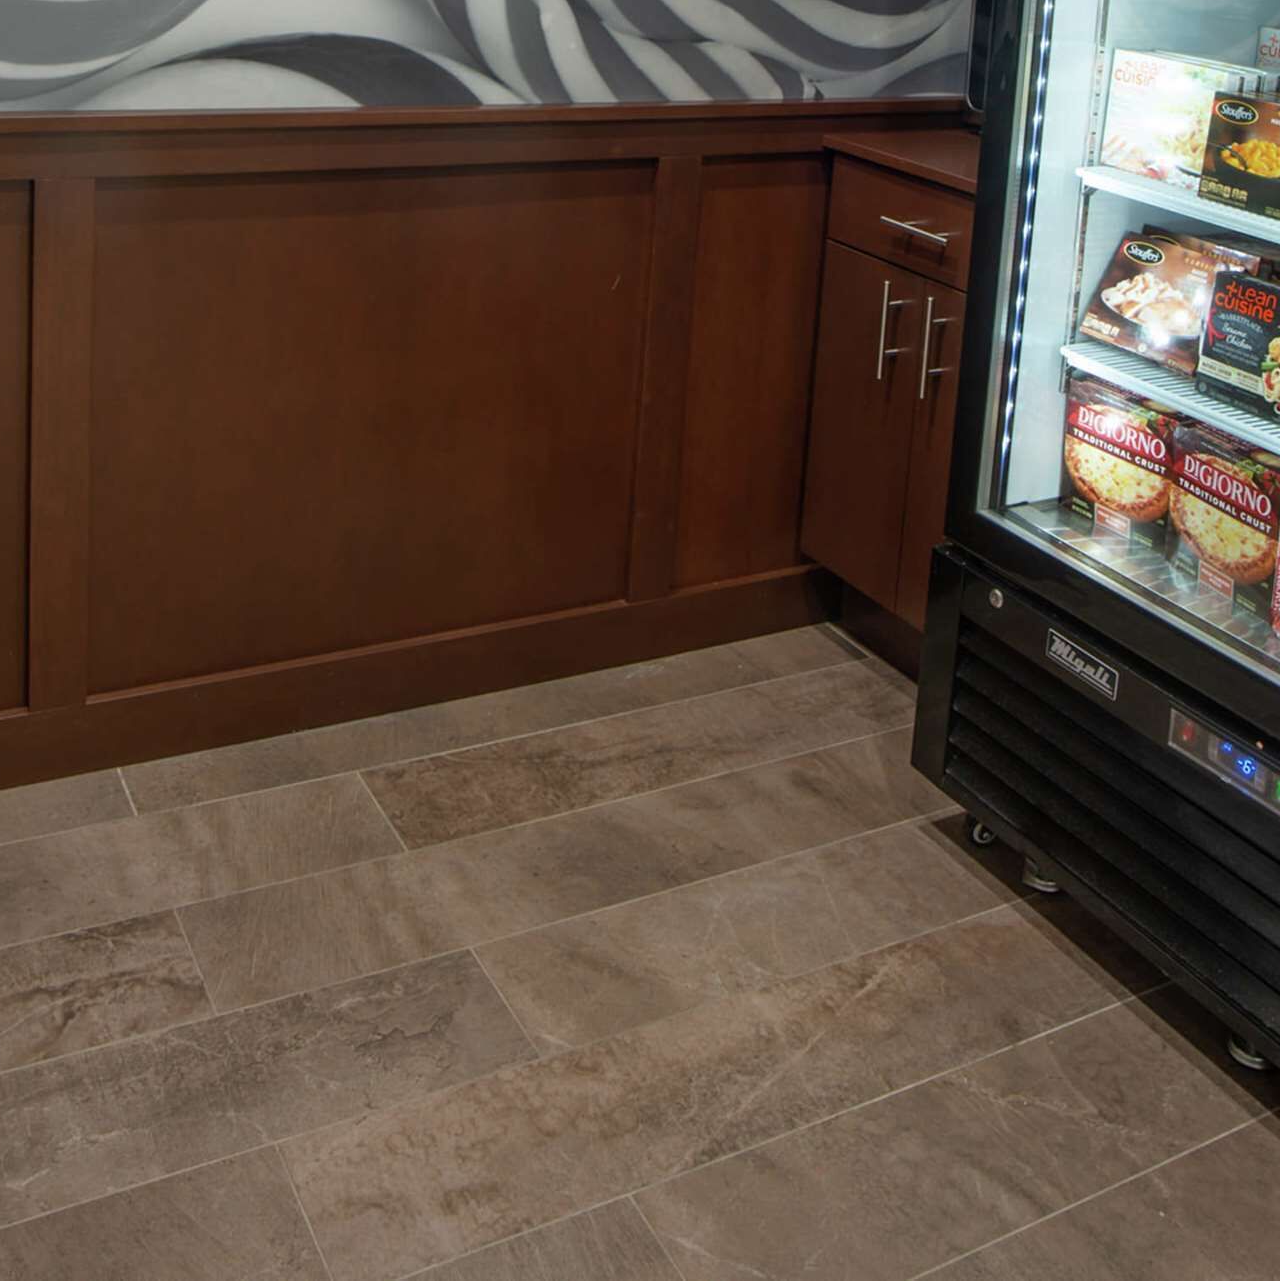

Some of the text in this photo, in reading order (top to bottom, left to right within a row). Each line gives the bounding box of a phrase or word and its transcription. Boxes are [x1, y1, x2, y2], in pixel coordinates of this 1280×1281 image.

[1237, 286, 1278, 309] Lean
[1072, 427, 1166, 476] TRADITIONAL CRUST
[1078, 405, 1166, 460] DIGIORNO
[1178, 477, 1272, 534] TRADITIONAL CRUST
[1183, 454, 1272, 518] DIGIORNO
